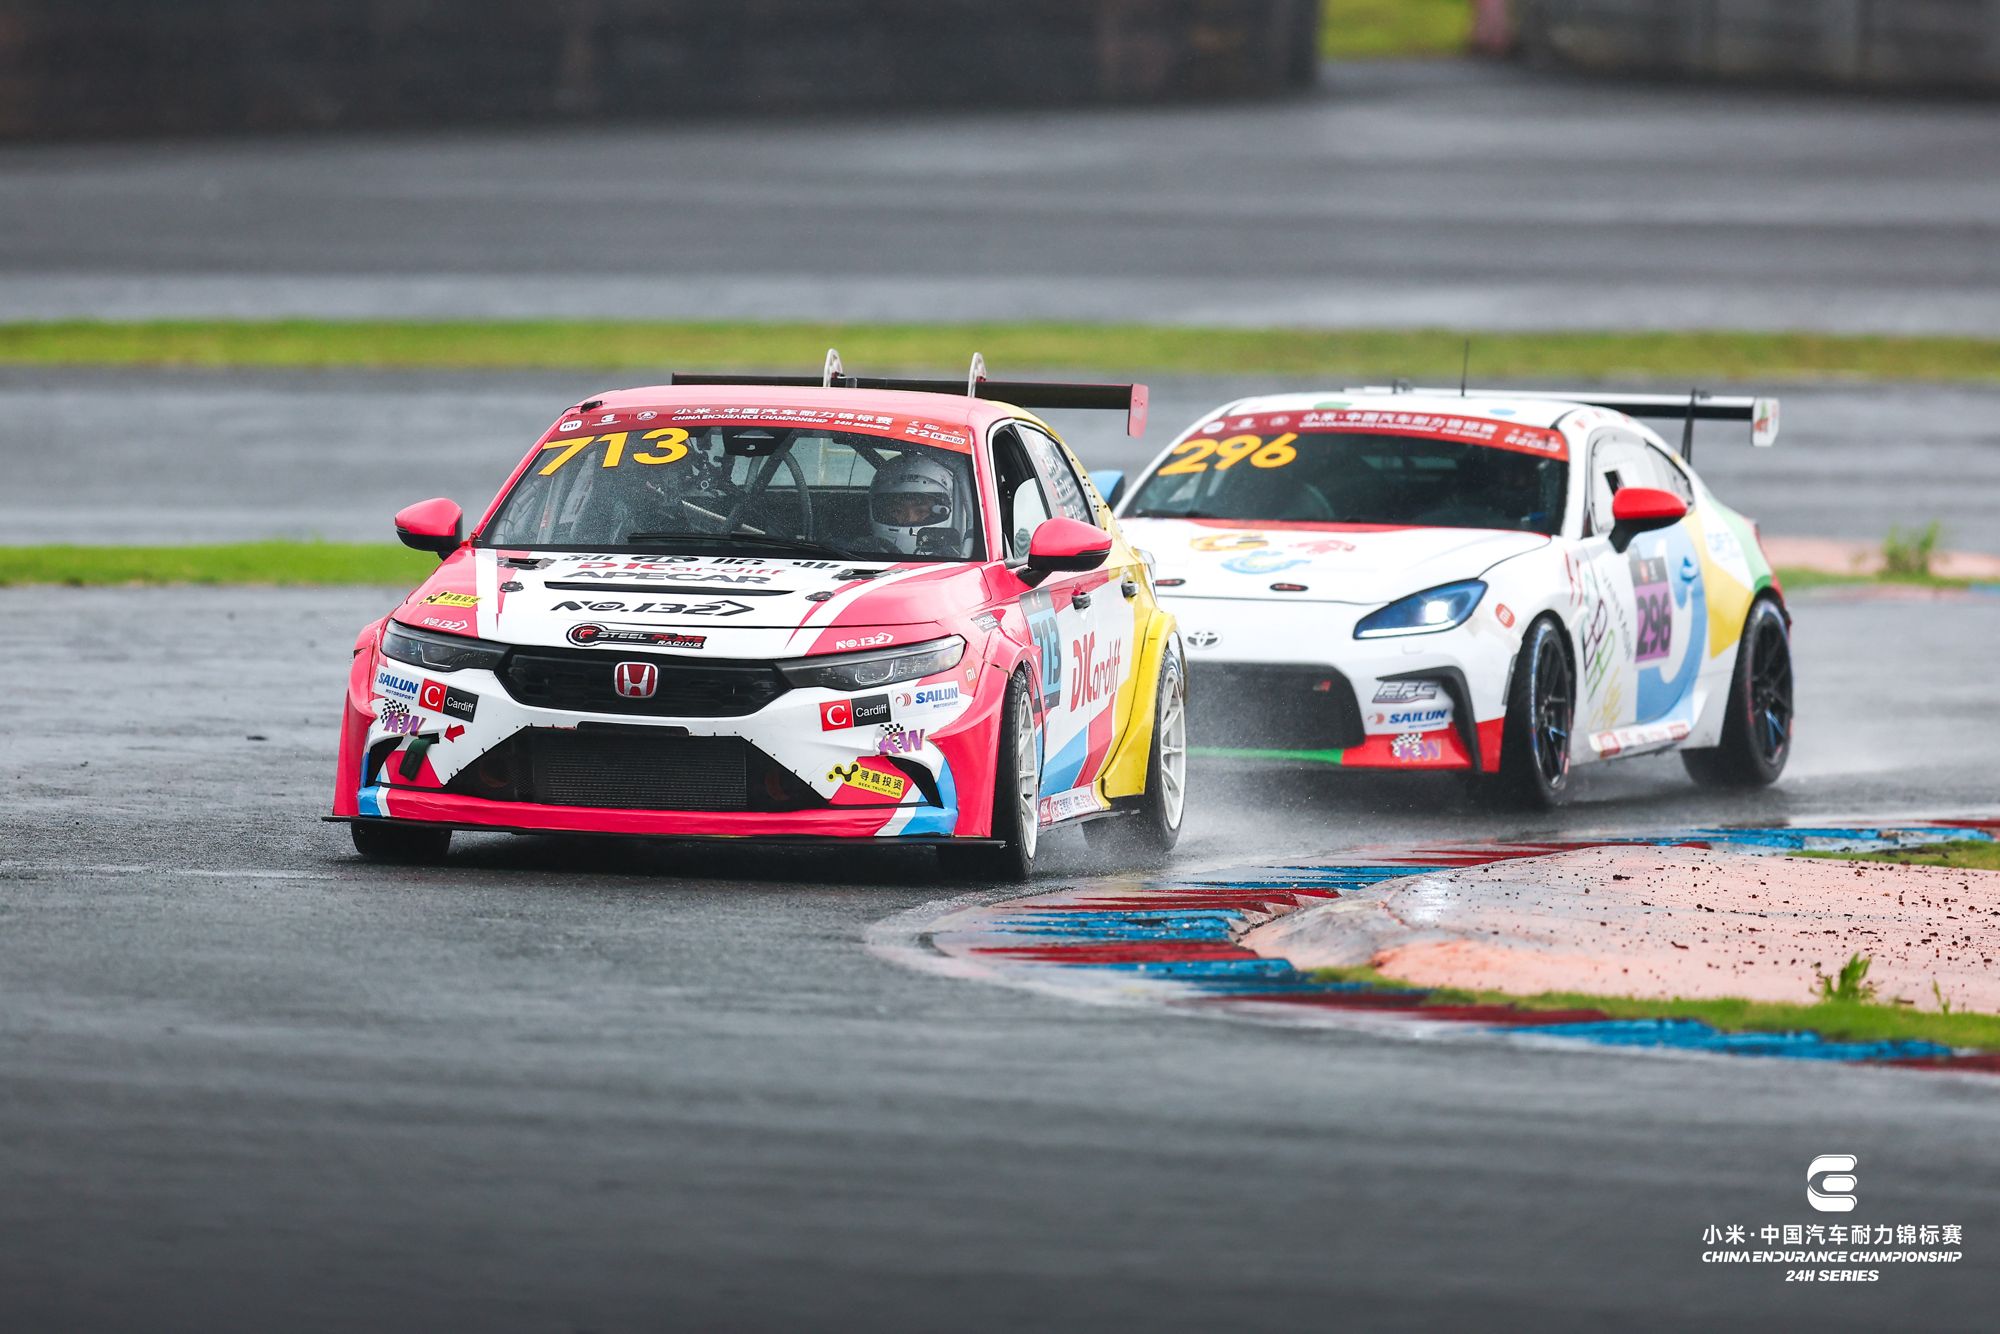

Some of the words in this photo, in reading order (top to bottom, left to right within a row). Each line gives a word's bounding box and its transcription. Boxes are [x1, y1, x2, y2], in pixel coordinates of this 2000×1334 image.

[905, 426, 930, 438] R2
[538, 427, 689, 476] 713
[1157, 432, 1298, 476] 296
[562, 571, 771, 584] APECAR
[1636, 592, 1670, 657] 296
[597, 631, 646, 640] STEEL
[651, 634, 705, 642] PLATE
[657, 640, 702, 648] RACING
[1032, 616, 1062, 685] 713
[378, 672, 419, 694] SAILUN
[385, 689, 414, 700] MOTORSPORT
[424, 686, 441, 707] C
[446, 697, 474, 713] Cardiff
[915, 687, 959, 704] SAILUN
[826, 705, 847, 726] C
[855, 704, 888, 717] Cardiff
[1389, 709, 1448, 724] SAILUN
[860, 769, 903, 791] 寻真投资
